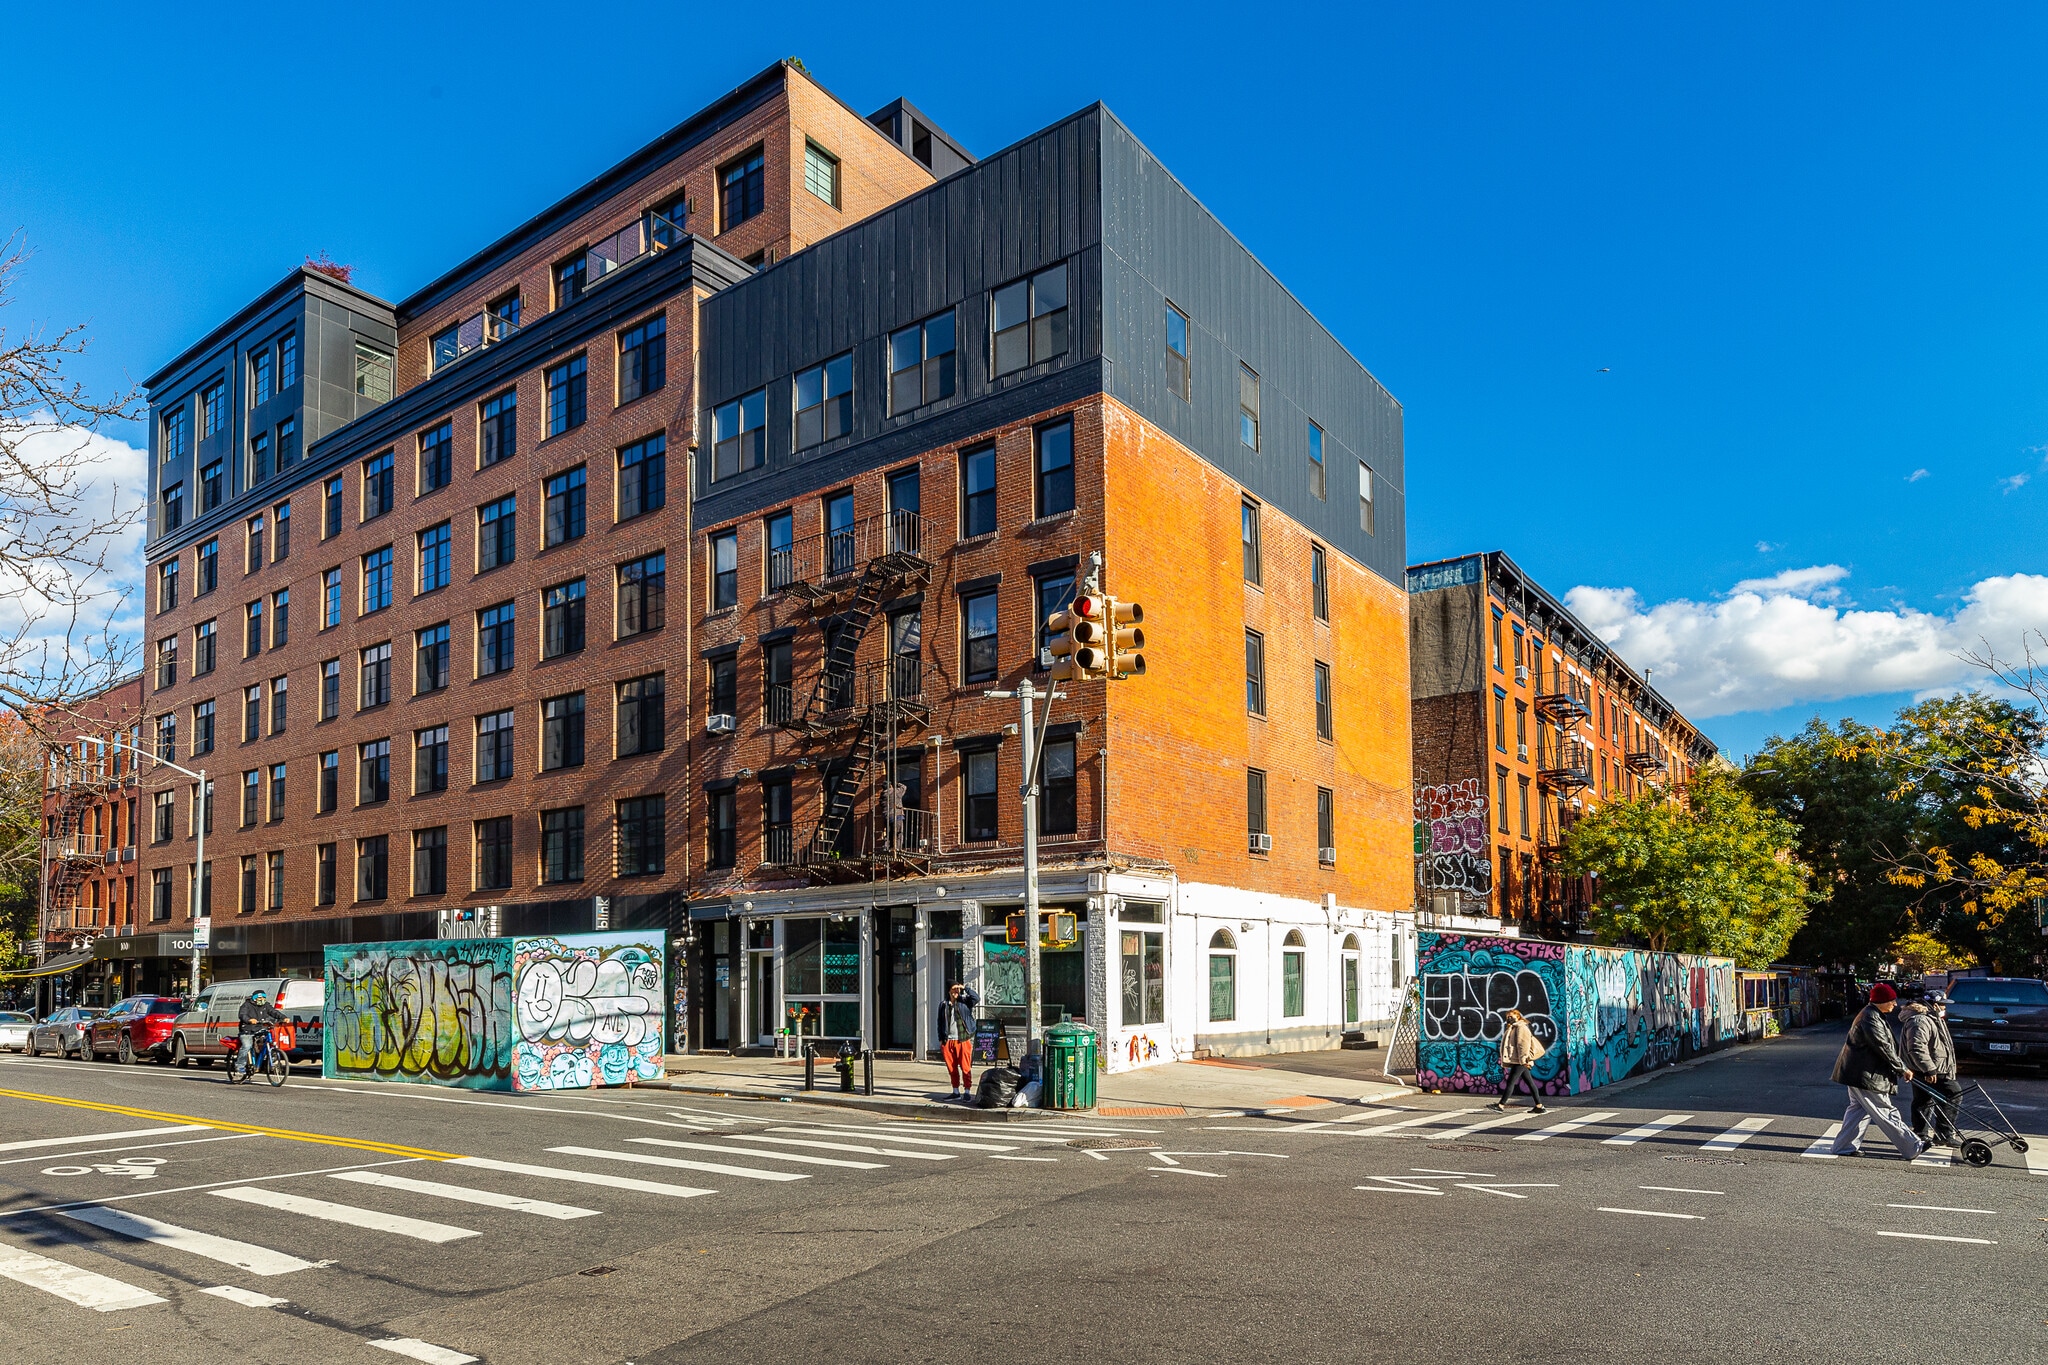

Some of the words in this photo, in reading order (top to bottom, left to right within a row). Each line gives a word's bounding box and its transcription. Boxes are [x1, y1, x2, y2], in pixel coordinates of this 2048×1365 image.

[438, 910, 488, 938] blink
[597, 896, 609, 929] blink
[293, 1015, 320, 1033] M
